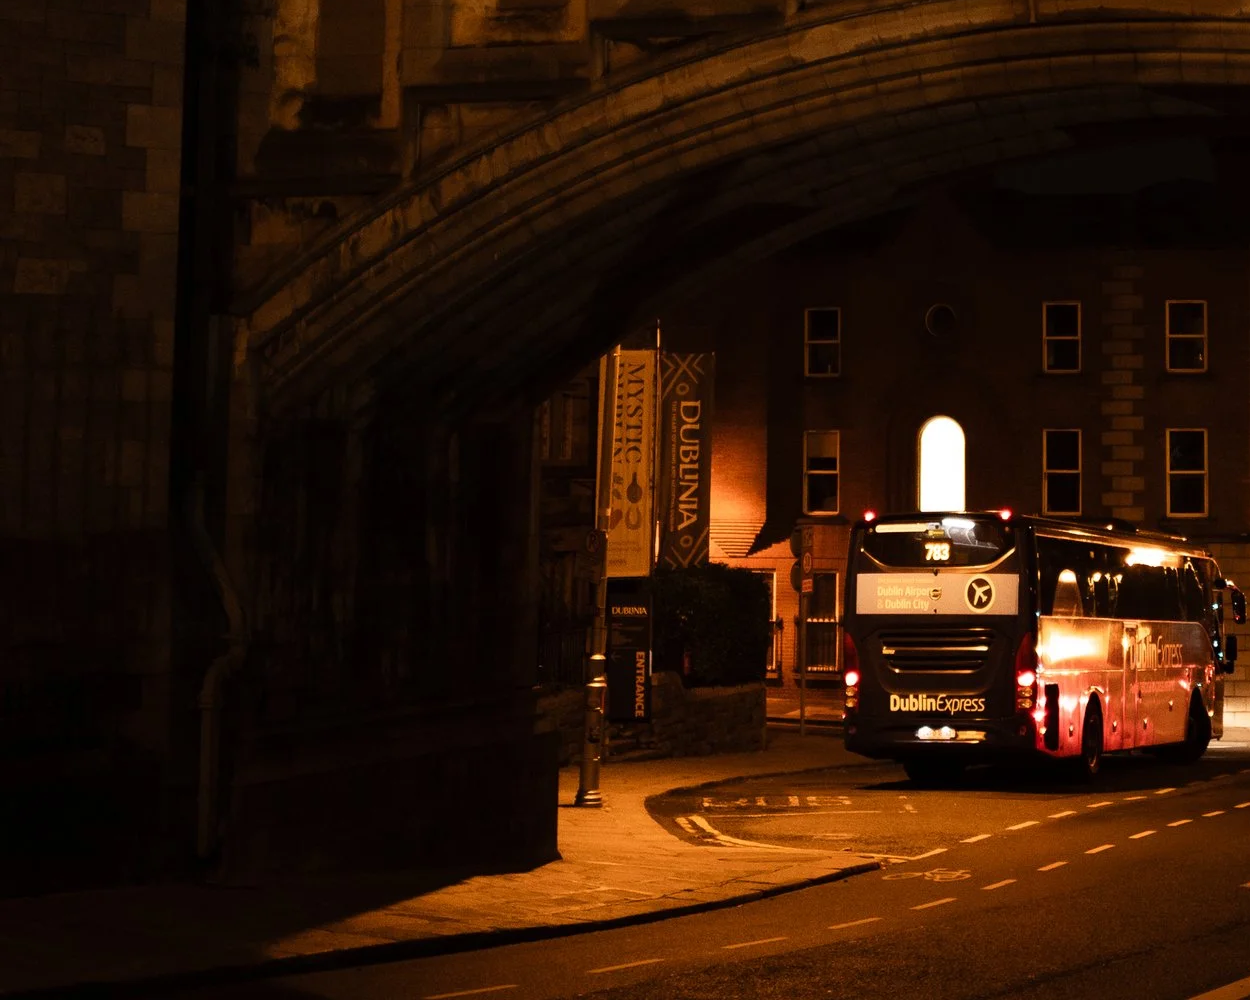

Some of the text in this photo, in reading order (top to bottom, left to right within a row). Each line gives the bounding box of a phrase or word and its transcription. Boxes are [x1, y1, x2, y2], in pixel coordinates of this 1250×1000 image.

[625, 361, 646, 464] MYSTIC
[677, 400, 701, 530] DUBLINIA
[924, 542, 950, 561] 783
[877, 586, 936, 597] Dublin Airpor
[611, 606, 648, 616] DUBLINIA
[885, 599, 911, 609] Dublin
[913, 599, 929, 611] City
[635, 651, 645, 717] ENTRANCE
[889, 694, 986, 714] DublinExpress
